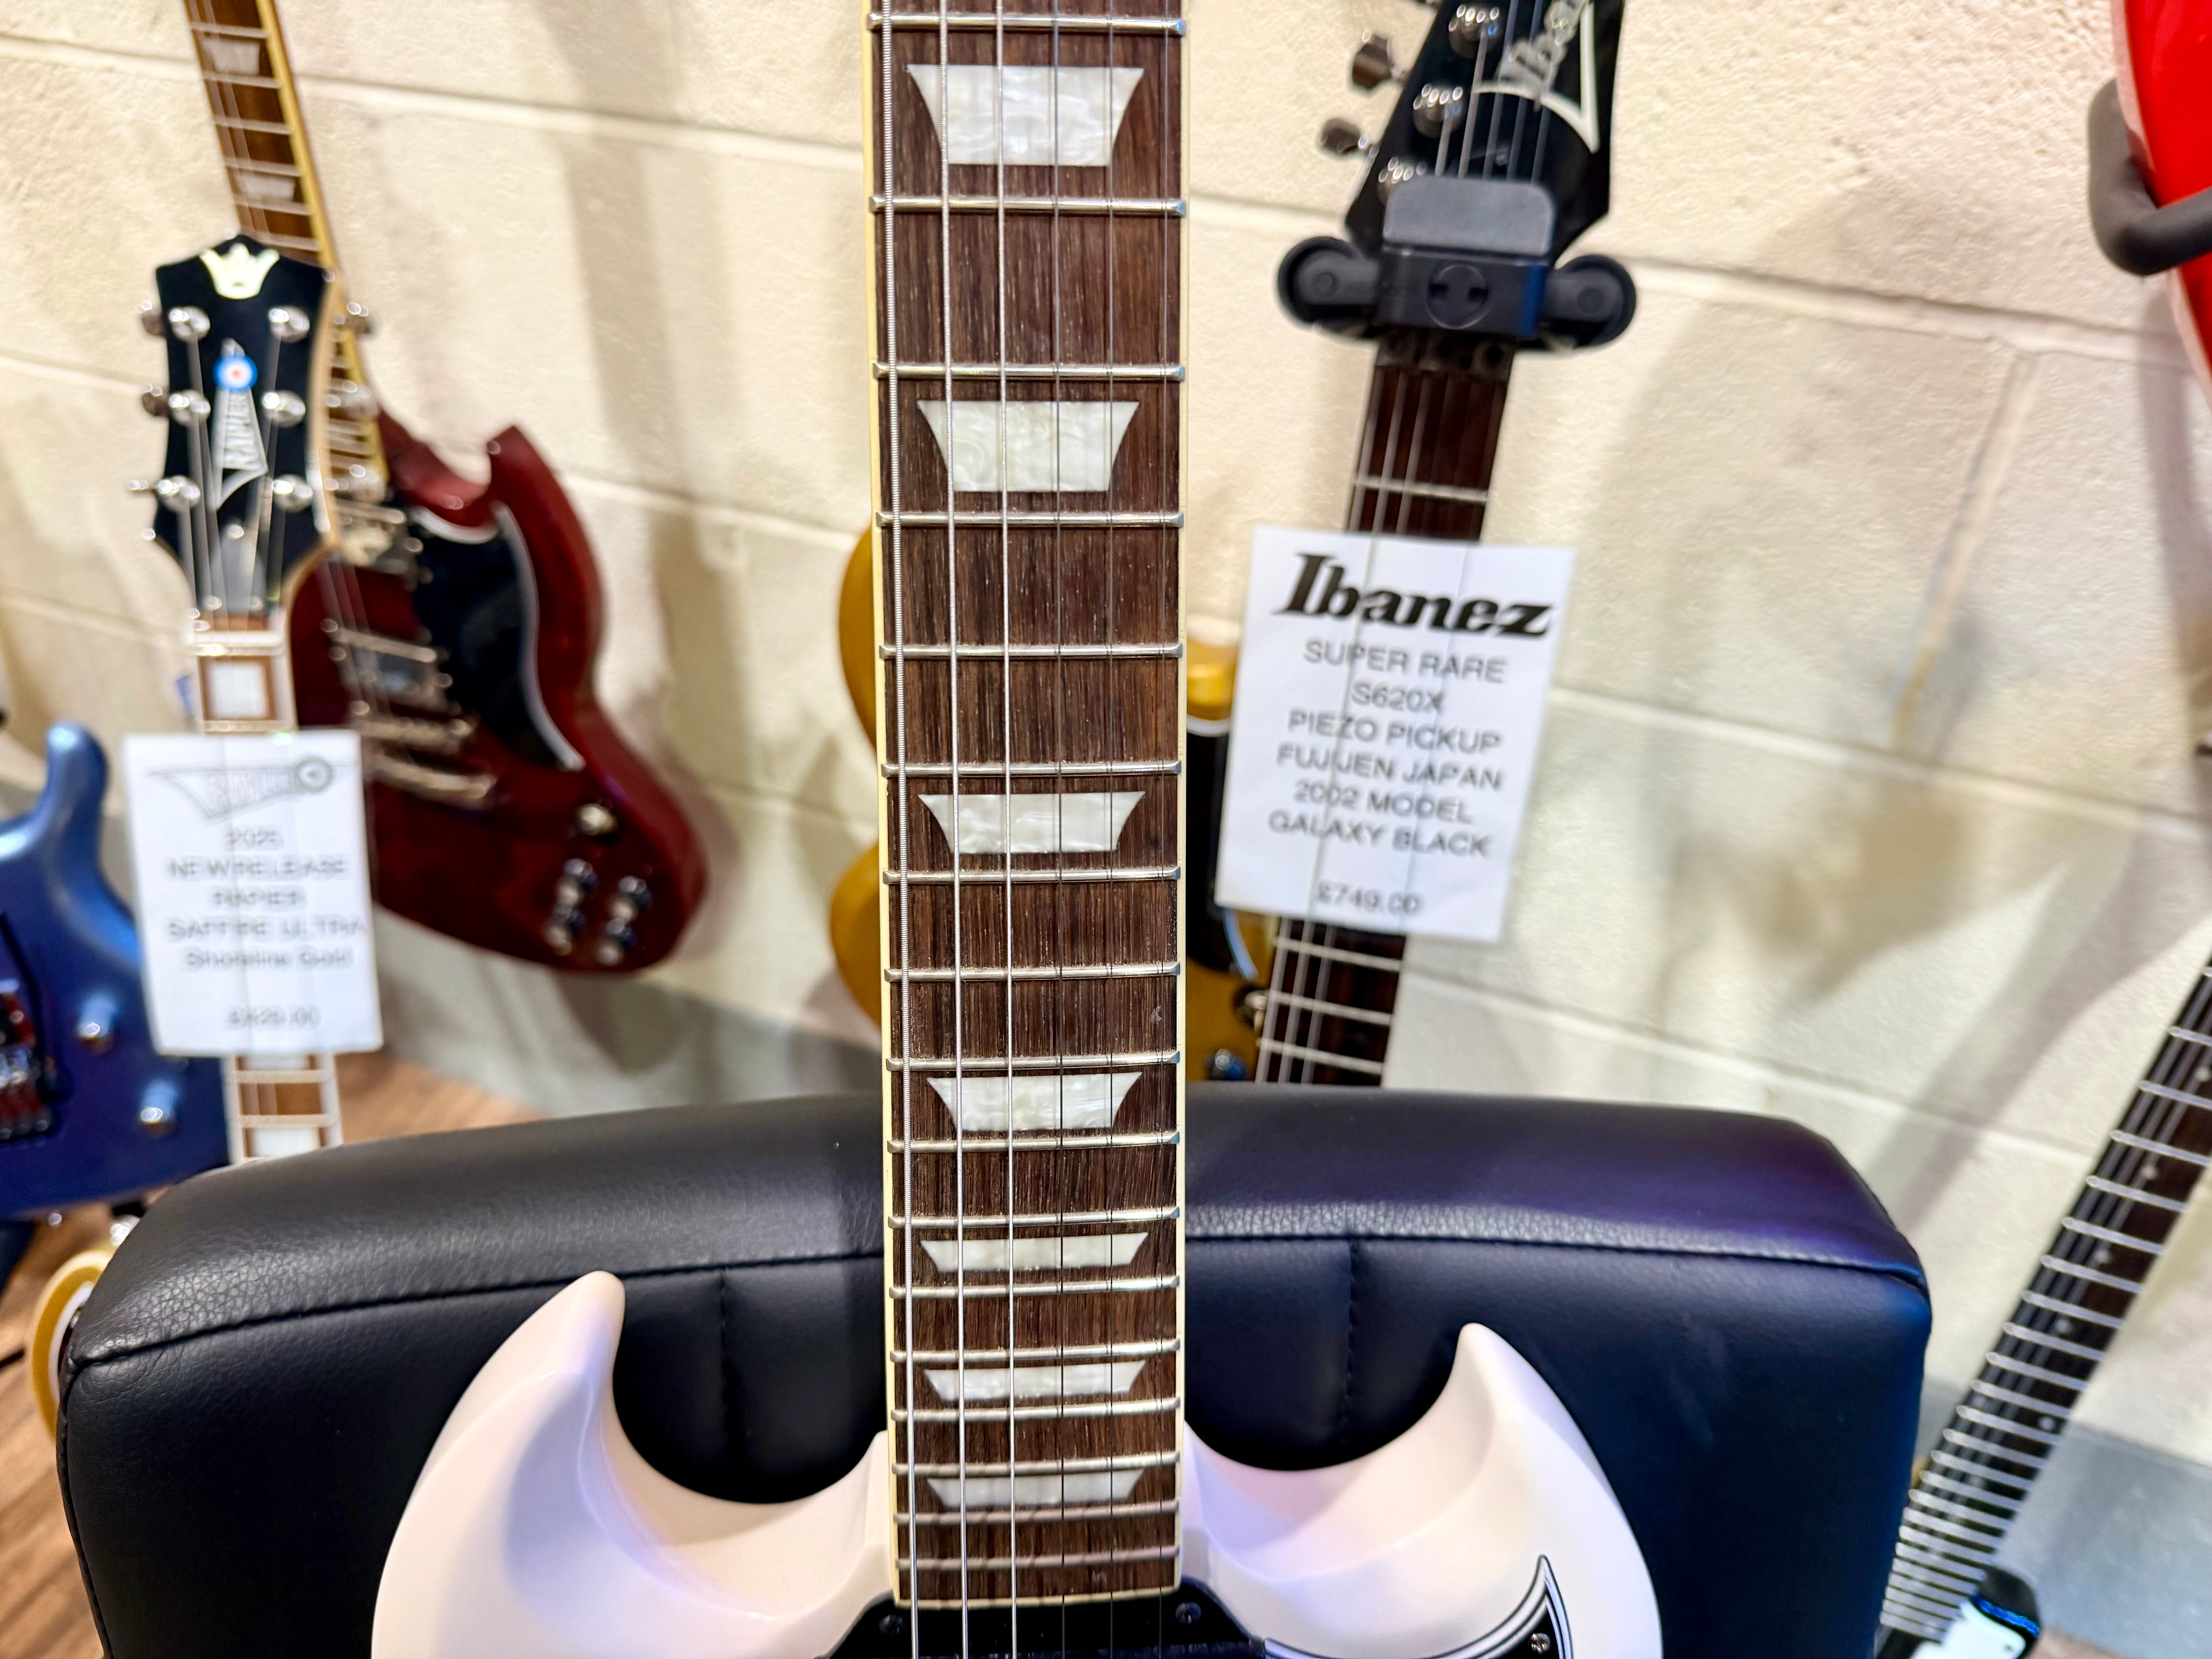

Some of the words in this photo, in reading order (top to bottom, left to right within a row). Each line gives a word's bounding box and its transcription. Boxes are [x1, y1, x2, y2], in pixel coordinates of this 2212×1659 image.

[1273, 551, 1555, 639] Ibanez
[1304, 639, 1408, 674] SUPER
[1418, 649, 1506, 684] RARE
[1351, 677, 1445, 716] S620X
[1288, 708, 1377, 743] PIEZO
[1386, 720, 1502, 755] PICKUP
[1401, 758, 1503, 792] JAPAN
[1293, 777, 1360, 811] 2002
[1366, 791, 1474, 826] MODEL
[1267, 808, 1387, 848] GALAXY
[1392, 826, 1492, 860] BLACK
[1316, 880, 1424, 915] £749.00
